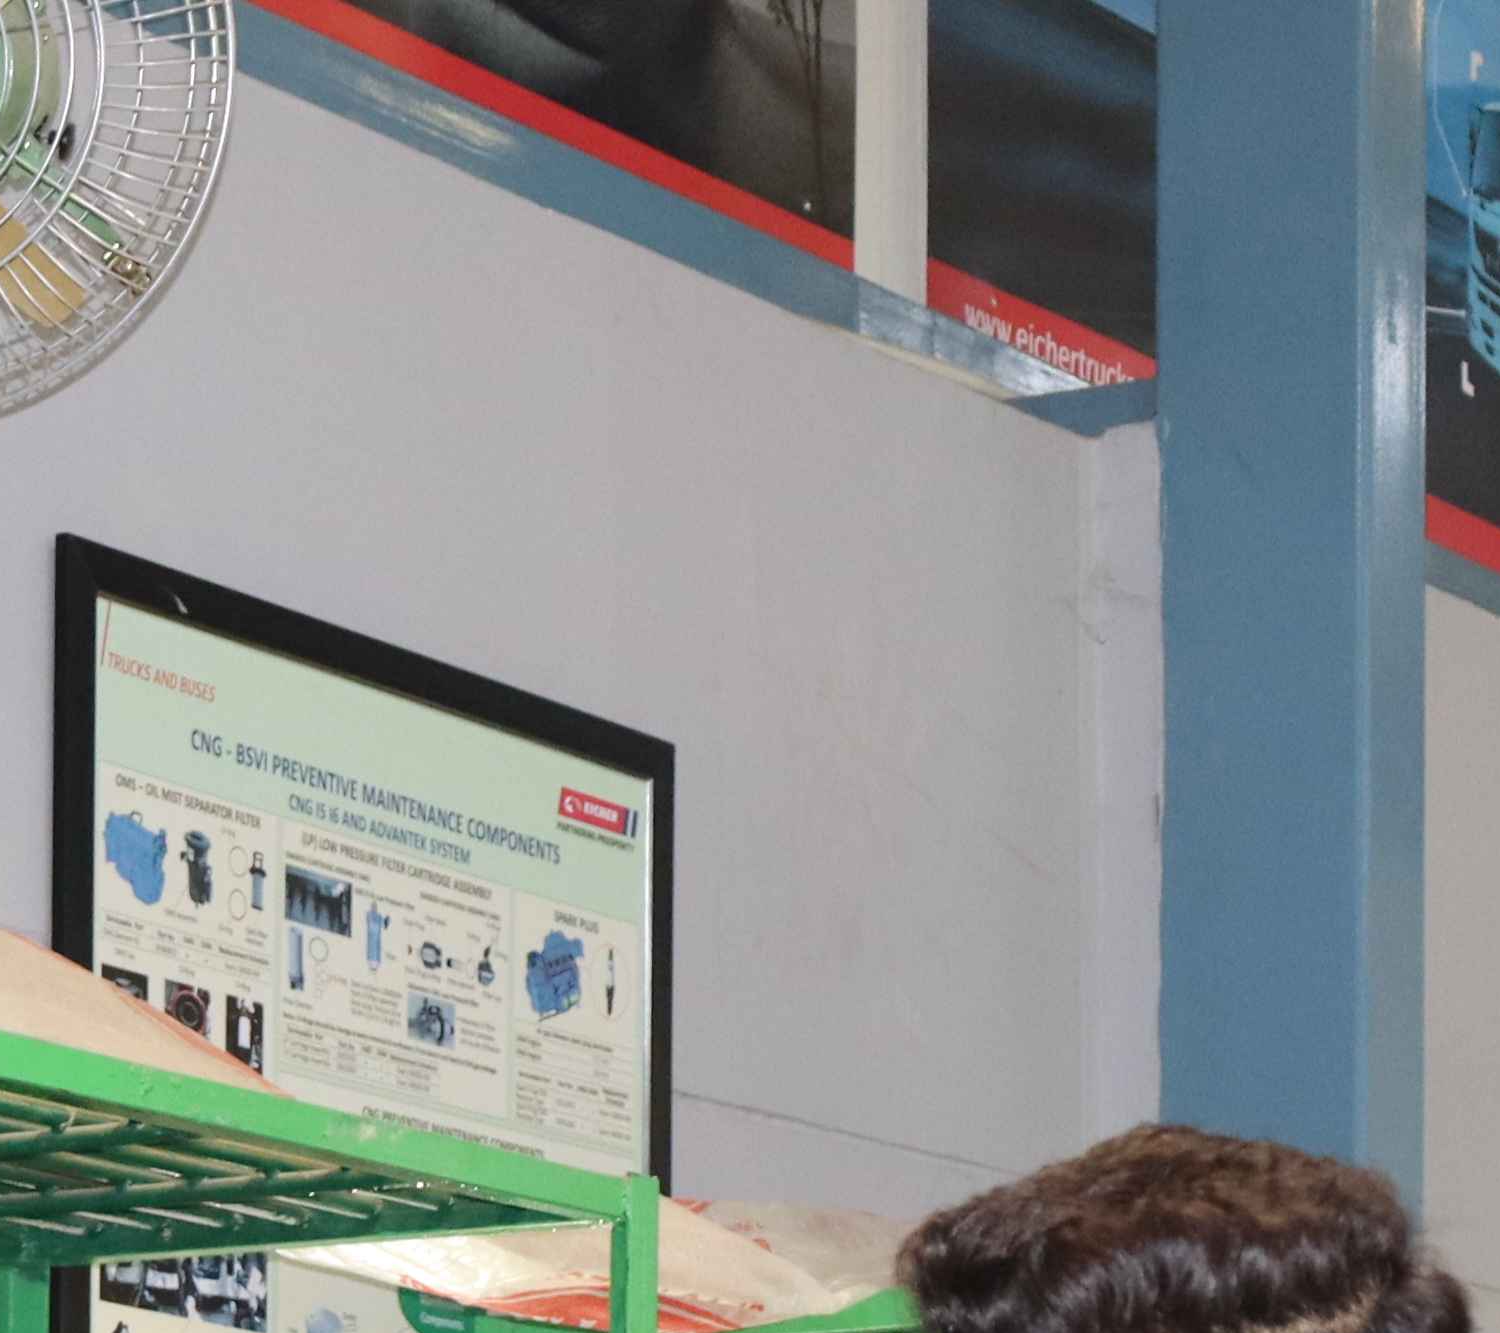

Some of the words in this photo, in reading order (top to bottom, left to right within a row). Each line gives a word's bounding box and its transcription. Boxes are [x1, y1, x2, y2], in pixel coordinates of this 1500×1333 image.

[108, 651, 151, 681] TRUCKS
[153, 669, 177, 690] AND
[180, 676, 216, 702] BUSES
[162, 788, 182, 806] MIST
[184, 793, 232, 820] SEPARATOR
[234, 809, 261, 829] FILTER
[191, 729, 222, 757] CNG
[237, 743, 268, 772] BSVI
[272, 754, 357, 800] PREVENTIVE
[362, 783, 464, 834] MAINTENANCE
[466, 818, 561, 865] COMPONENTS
[289, 793, 313, 815] CNG
[341, 810, 367, 832] AND
[370, 818, 426, 850] ADVANTEK
[430, 838, 471, 864] SYSTEM
[340, 845, 379, 867] PRESSURE
[381, 855, 405, 874] FILTER
[408, 862, 451, 887] CARTRIDGE
[553, 911, 577, 930] SPARK
